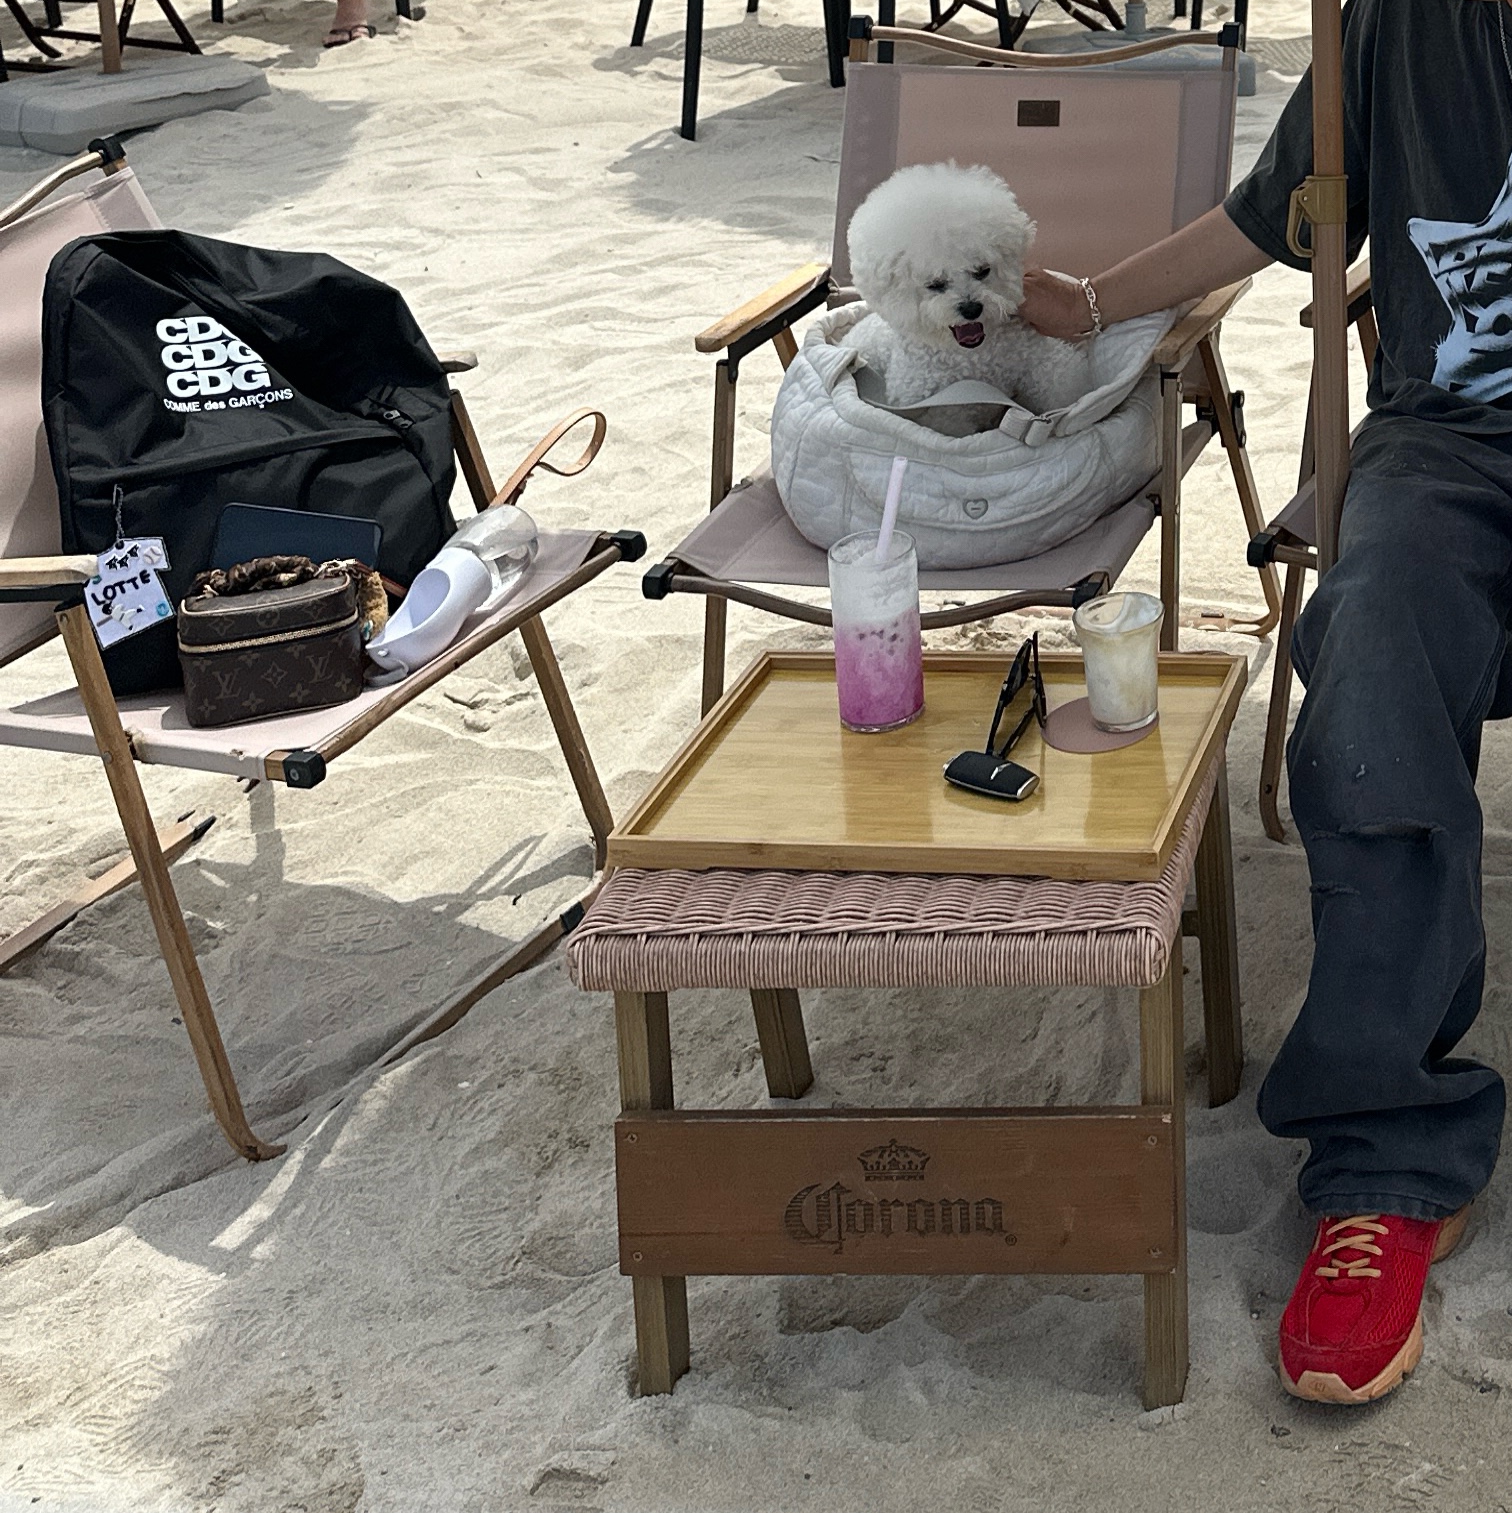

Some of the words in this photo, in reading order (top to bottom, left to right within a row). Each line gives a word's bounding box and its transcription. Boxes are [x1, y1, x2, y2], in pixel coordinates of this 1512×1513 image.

[166, 362, 272, 398] CDG
[163, 398, 201, 413] COMME
[204, 400, 227, 411] des
[228, 388, 294, 409] GARÇONS
[91, 569, 151, 606] LOTTE
[784, 1181, 1008, 1255] Corona
